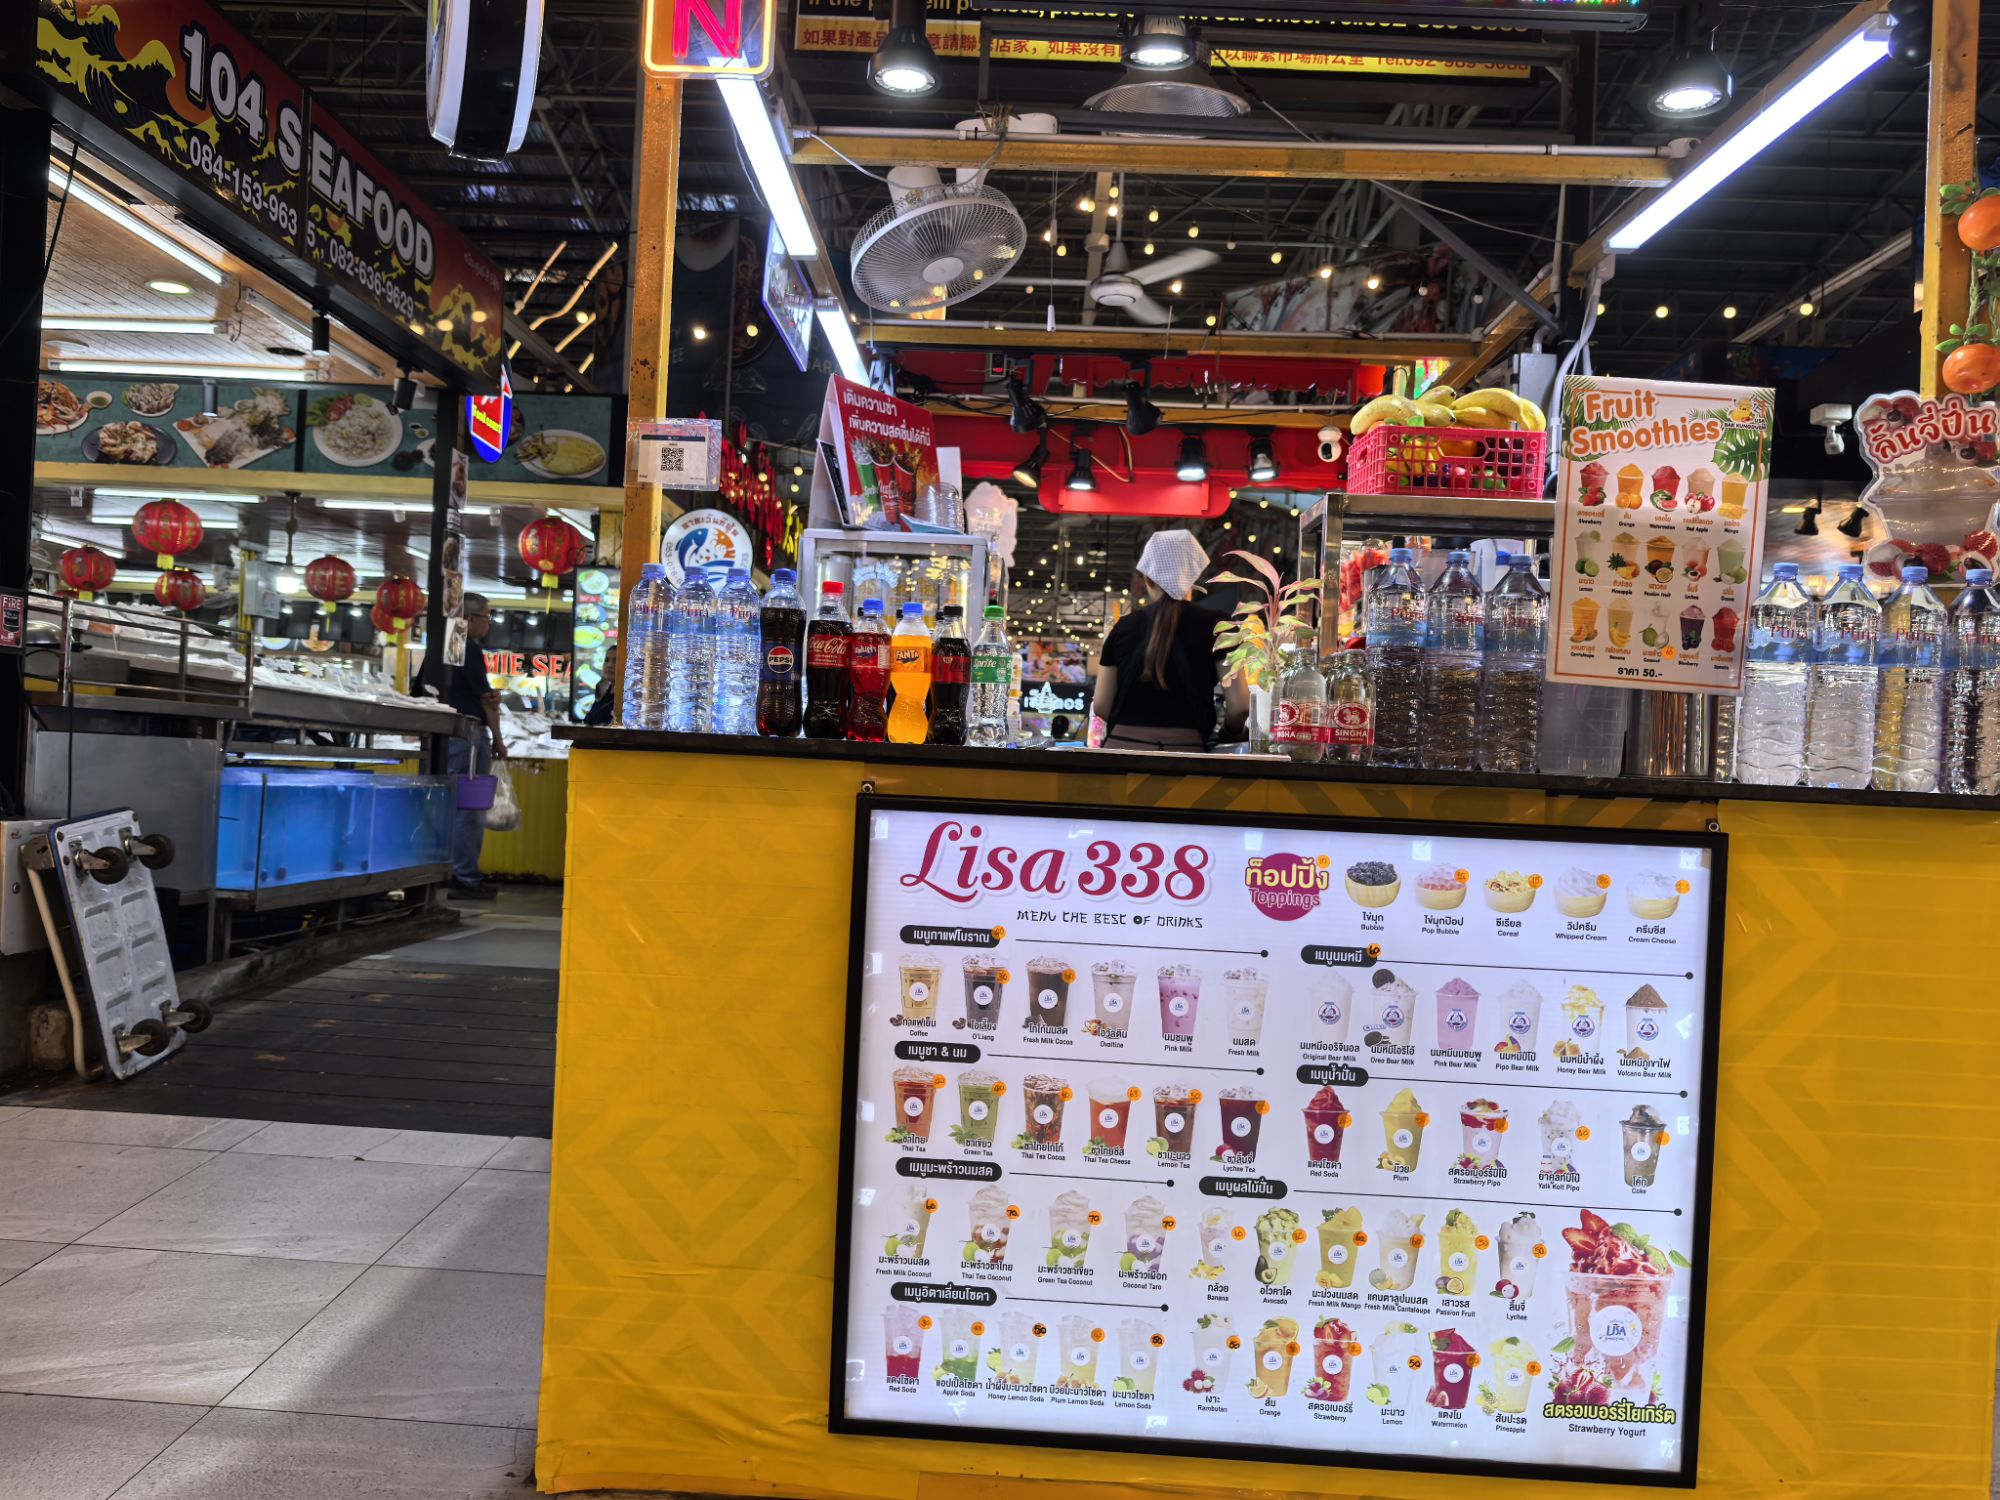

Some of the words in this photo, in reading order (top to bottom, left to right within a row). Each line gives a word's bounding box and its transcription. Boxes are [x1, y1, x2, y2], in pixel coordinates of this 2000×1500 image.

[184, 29, 265, 141] 104
[277, 107, 434, 277] SEAFOOD
[329, 242, 414, 319] 082-636-9629
[1586, 389, 1656, 421] Fruit
[1871, 400, 1991, 459] ลิ้นจี่ปั่น
[1571, 417, 1721, 455] Smoothies
[2, 596, 21, 610] FIRE
[808, 638, 848, 655] Coca-Cola
[896, 650, 919, 659] FANTA
[768, 656, 792, 664] PEPSI
[974, 658, 997, 668] Sprite
[1618, 667, 1639, 676] ราคา
[1643, 667, 1663, 677] 50.-
[1335, 729, 1368, 738] SINGHA
[900, 821, 1066, 903] Lisa
[1078, 840, 1208, 900] 338
[1245, 857, 1329, 889] ท็อปปิ้ง
[1249, 889, 1321, 909] Toppings
[1362, 911, 1384, 925] ไข่มุก
[1495, 918, 1522, 928] ซีเรียล
[1422, 927, 1435, 935] Pop
[1567, 922, 1597, 932] วิปครีม
[1636, 925, 1666, 935] ครีมชีส
[913, 928, 990, 945] เมนูกาแฟโบราณ
[1555, 932, 1585, 941] Whipped
[1586, 933, 1607, 941] Cream
[1651, 937, 1677, 945] Cheese
[1315, 949, 1363, 965] เมนูนมหมี
[972, 1033, 995, 1042] O'Liang
[1023, 1036, 1039, 1044] Fresh
[1055, 1038, 1073, 1046] Cocoa
[1233, 1037, 1256, 1047] นมสด
[1100, 1041, 1124, 1049] Ovaltine
[1164, 1044, 1178, 1052] Pink
[1179, 1045, 1193, 1053] Milk
[908, 1045, 937, 1060] เมนูชา
[941, 1046, 950, 1056] &
[953, 1047, 967, 1058] นม
[1228, 1048, 1245, 1056] Fresh
[1246, 1049, 1260, 1057] Milk
[1430, 1048, 1482, 1062] นมหมีนมชมพู
[1434, 1060, 1447, 1068] Pink
[1495, 1063, 1510, 1072] Pipo
[1310, 1063, 1356, 1084] เมนูน้ำปั่น
[1557, 1067, 1576, 1075] Honey
[1578, 1067, 1592, 1075] Bear
[1617, 1069, 1642, 1078] Volcano
[1658, 1071, 1672, 1079] Milk
[901, 1144, 913, 1152] Thai
[964, 1148, 980, 1156] Green
[1047, 1153, 1066, 1161] Cocoa
[1098, 1156, 1109, 1164] Tea
[1110, 1157, 1131, 1165] Cheese
[909, 1160, 993, 1177] เมนูมะพร้าวนมสด
[1223, 1165, 1244, 1173] Lychee
[1310, 1170, 1322, 1178] Red
[1215, 1179, 1274, 1196] เมนูผลไม้ปั่น
[1453, 1178, 1486, 1187] Strawberry
[1487, 1179, 1501, 1187] Pipo
[1162, 1220, 1174, 1228] 70
[878, 1254, 930, 1267] มะพร้าวนมสด
[893, 1269, 906, 1277] Milk
[907, 1270, 932, 1278] Coconut
[987, 1273, 1012, 1282] Coconut
[904, 1284, 990, 1301] เมนูอิตาเลี่ยนโซดา
[1207, 1282, 1229, 1293] กล้วย
[1260, 1286, 1292, 1297] อโวคาโด
[1207, 1294, 1229, 1302] Banana
[1312, 1288, 1359, 1300] มะม่วงนมสด
[1263, 1297, 1288, 1305] Avocado
[1326, 1300, 1340, 1308] Milk
[1341, 1301, 1362, 1310] Mango
[1442, 1298, 1470, 1309] เสาวรส
[1364, 1303, 1381, 1311] Fresh
[1382, 1304, 1396, 1312] Milk
[1397, 1305, 1431, 1315] Cantaloupe
[1435, 1308, 1460, 1316] Passion
[1506, 1313, 1528, 1321] Lychee
[1606, 1323, 1626, 1337] LISA
[1112, 1390, 1155, 1401] มะนาวโซดา
[1205, 1395, 1221, 1404] เงาะ
[1197, 1405, 1228, 1413] Rambutan
[1259, 1409, 1281, 1417] Orange
[1381, 1408, 1405, 1417] มะนาว
[1544, 1399, 1676, 1423] สตรอเบอร์รี่โยเกิร์ต
[1313, 1413, 1347, 1423] Strawberry
[1438, 1409, 1462, 1420] แตงโม
[1495, 1412, 1527, 1425] สับปะรด
[1431, 1420, 1468, 1429] Watermelon
[1495, 1425, 1526, 1434] Pineapple
[1569, 1424, 1616, 1437] Strawberry
[1618, 1427, 1646, 1438] Yogurt
